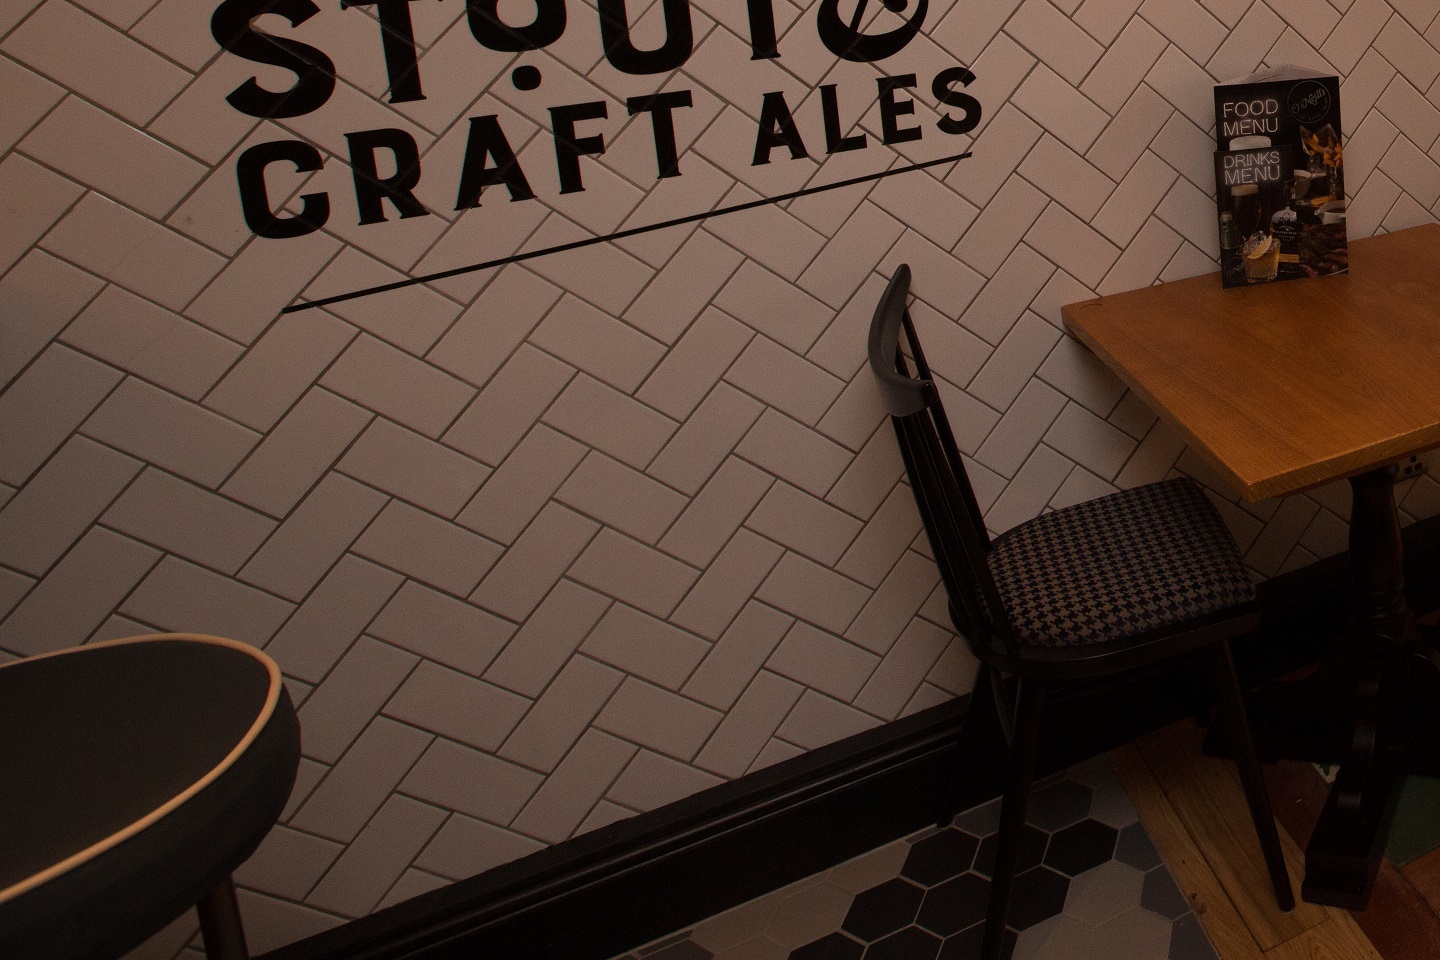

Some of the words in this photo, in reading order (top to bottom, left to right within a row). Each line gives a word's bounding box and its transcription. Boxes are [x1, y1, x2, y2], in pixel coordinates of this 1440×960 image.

[1223, 98, 1279, 119] FOOD
[1223, 118, 1279, 137] MENU
[236, 90, 694, 239] CRAFT
[751, 66, 983, 167] ALES
[1223, 151, 1281, 169] DRINKS
[1224, 165, 1281, 186] MENU
